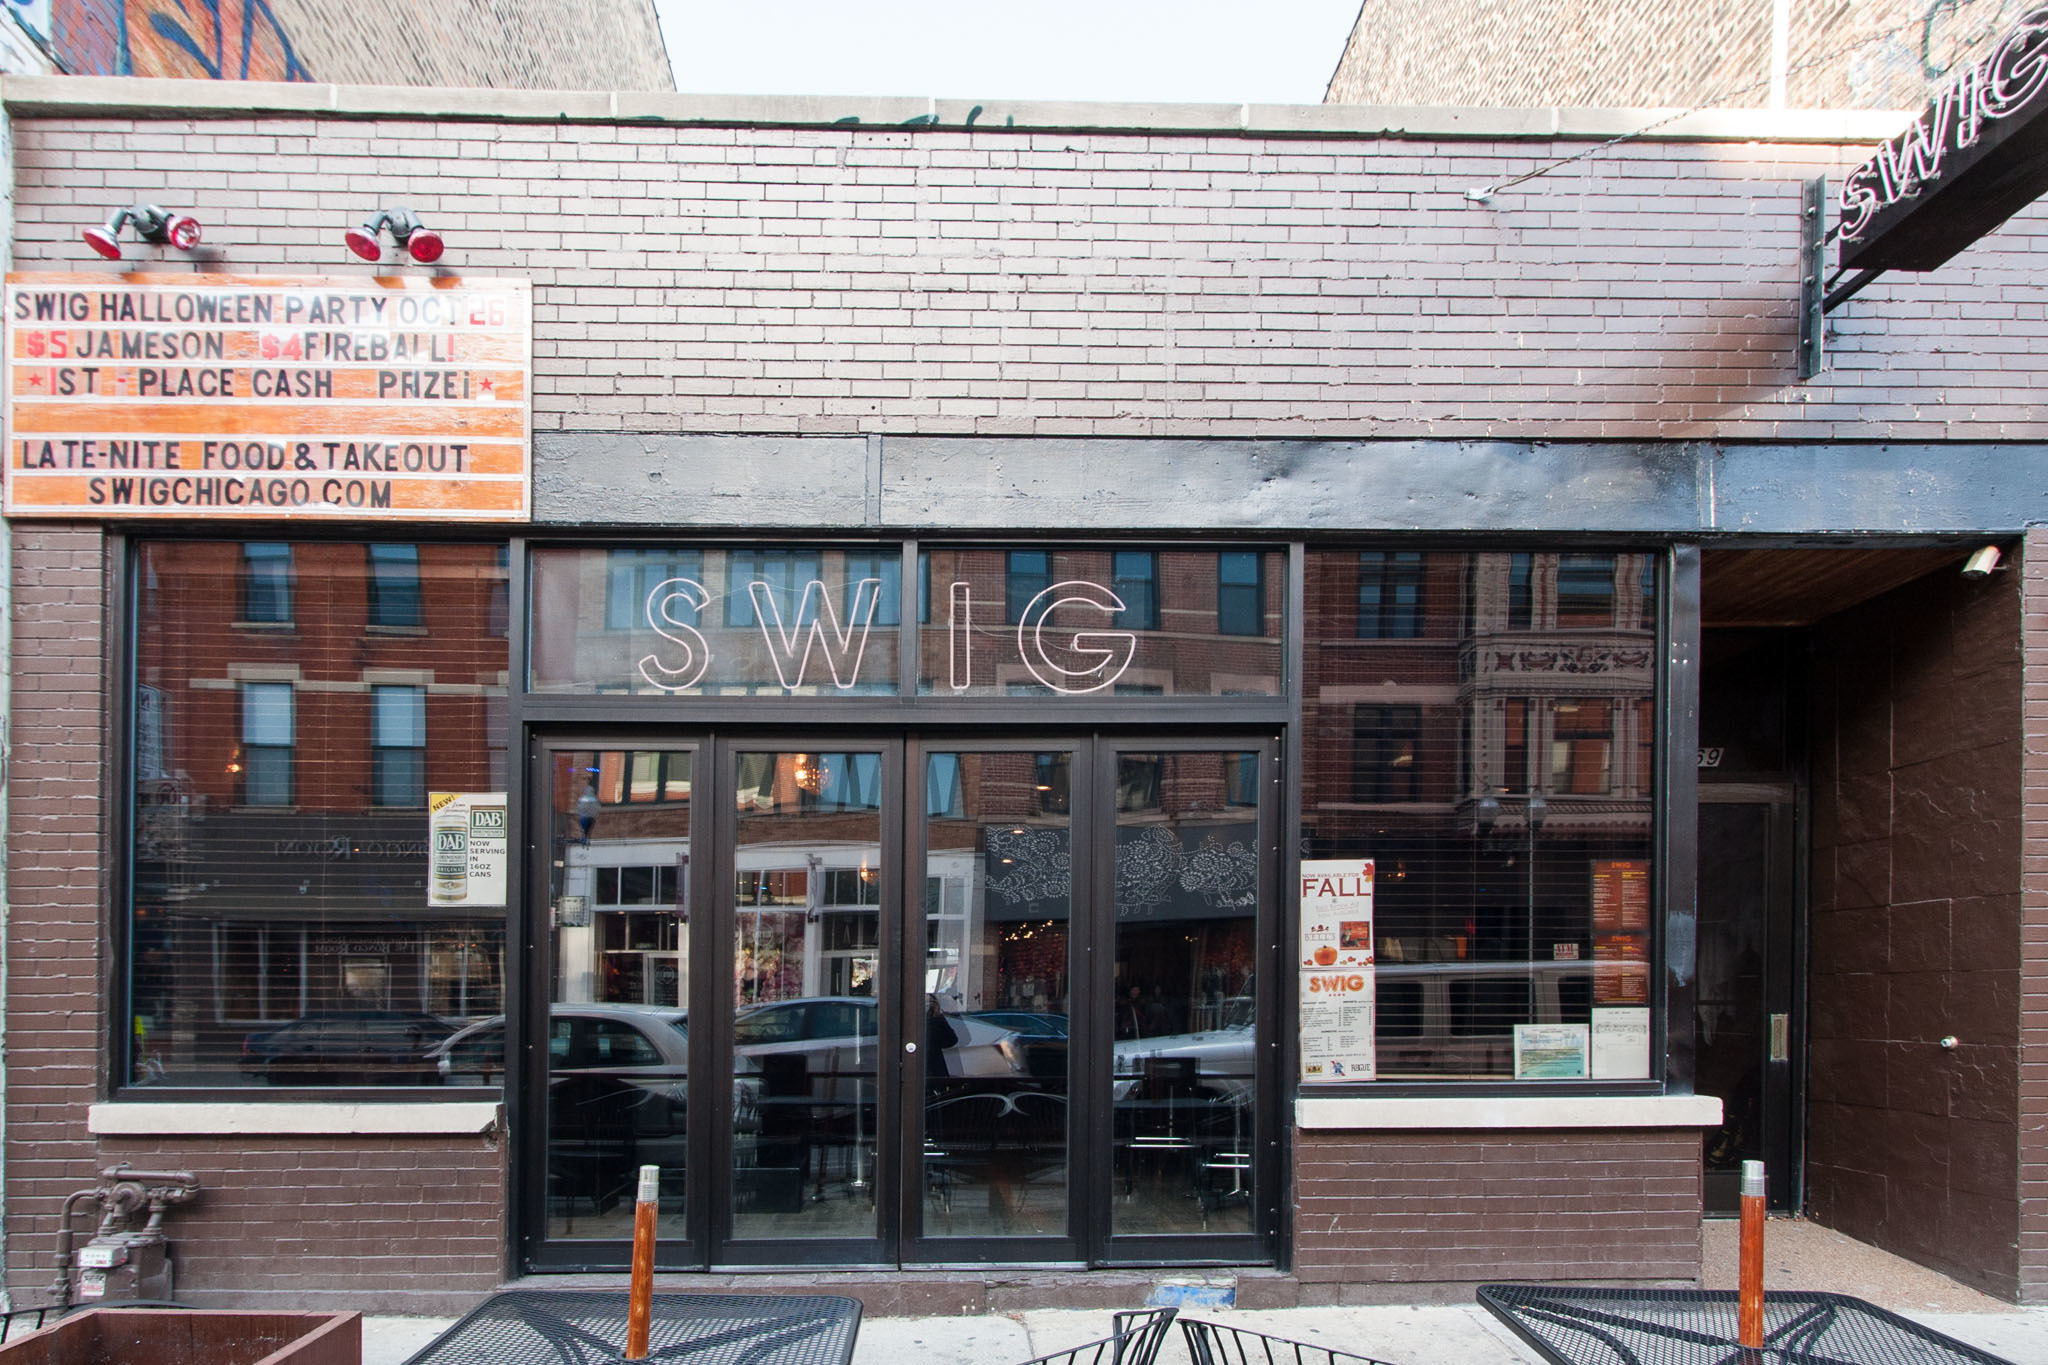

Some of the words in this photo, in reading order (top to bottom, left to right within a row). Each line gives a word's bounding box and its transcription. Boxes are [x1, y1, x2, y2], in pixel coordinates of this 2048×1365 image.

[1837, 8, 2048, 240] SWIG
[14, 292, 90, 321] SWIG
[101, 293, 273, 323] HALLOWEEN
[285, 296, 387, 324] PARTY
[399, 297, 460, 325] OCT
[469, 299, 505, 326] 26
[27, 331, 67, 358] $5
[76, 331, 224, 359] JAMESON
[261, 333, 303, 361] $4
[139, 368, 234, 397] PLACE
[253, 369, 332, 398] CASH
[23, 441, 181, 469] LATE-NITE
[203, 441, 286, 471] FOOD
[294, 443, 317, 470] &
[322, 442, 468, 473] TAKEOUT
[638, 578, 1137, 694] SWIG
[432, 793, 456, 812] NEW!
[475, 812, 502, 827] DAB
[438, 834, 465, 850] DAB
[1302, 877, 1372, 898] FALL
[1309, 975, 1364, 993] SWIG
